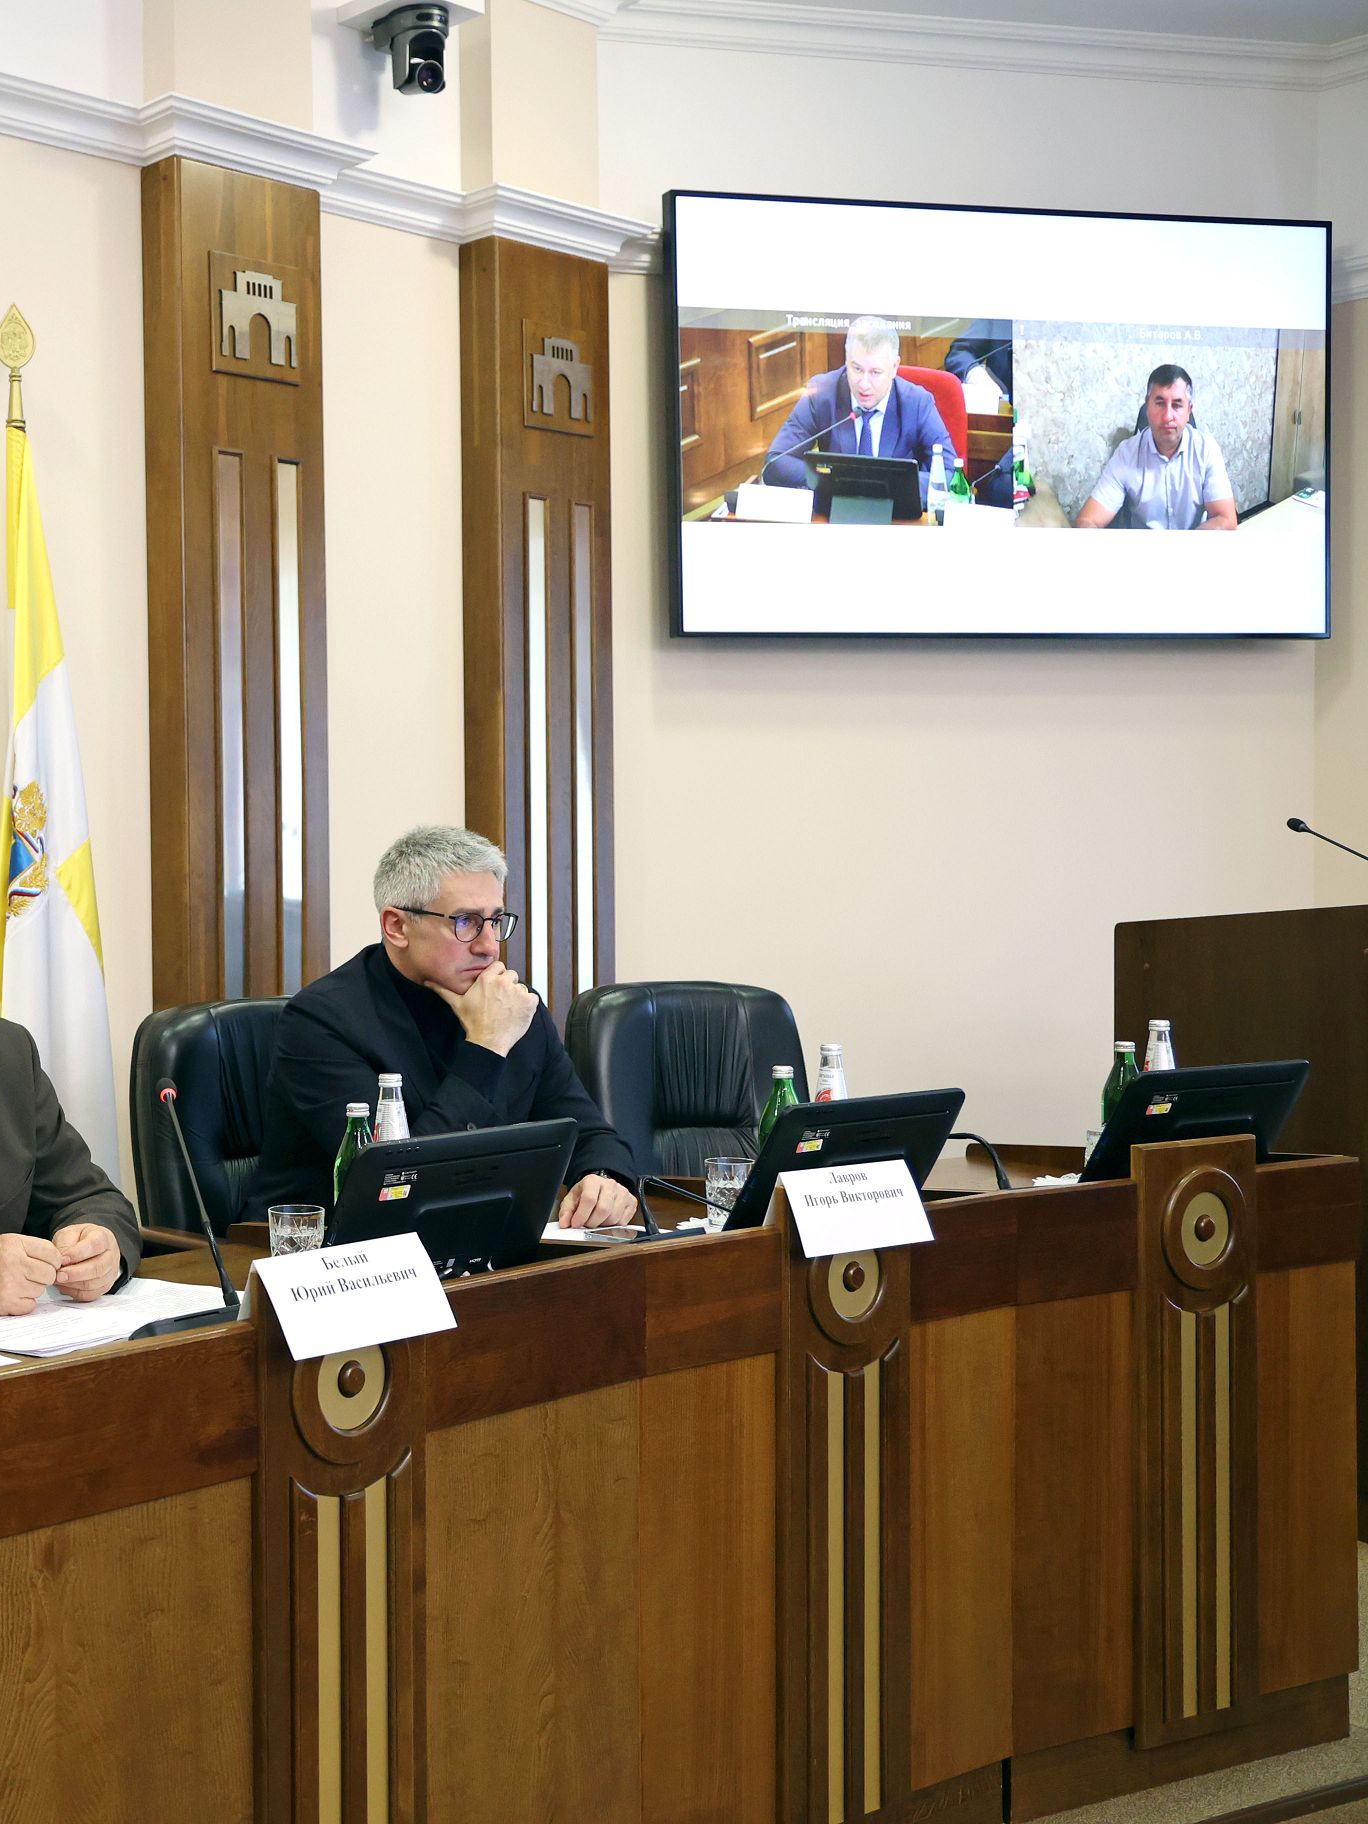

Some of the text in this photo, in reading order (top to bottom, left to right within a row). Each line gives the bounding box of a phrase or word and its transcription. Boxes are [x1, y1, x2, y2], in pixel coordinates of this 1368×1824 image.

[829, 1171, 868, 1186] Лавров
[803, 1187, 904, 1209] Игорь Викторович
[320, 1249, 369, 1271] Белый
[289, 1267, 418, 1304] Юрий Васильевич
